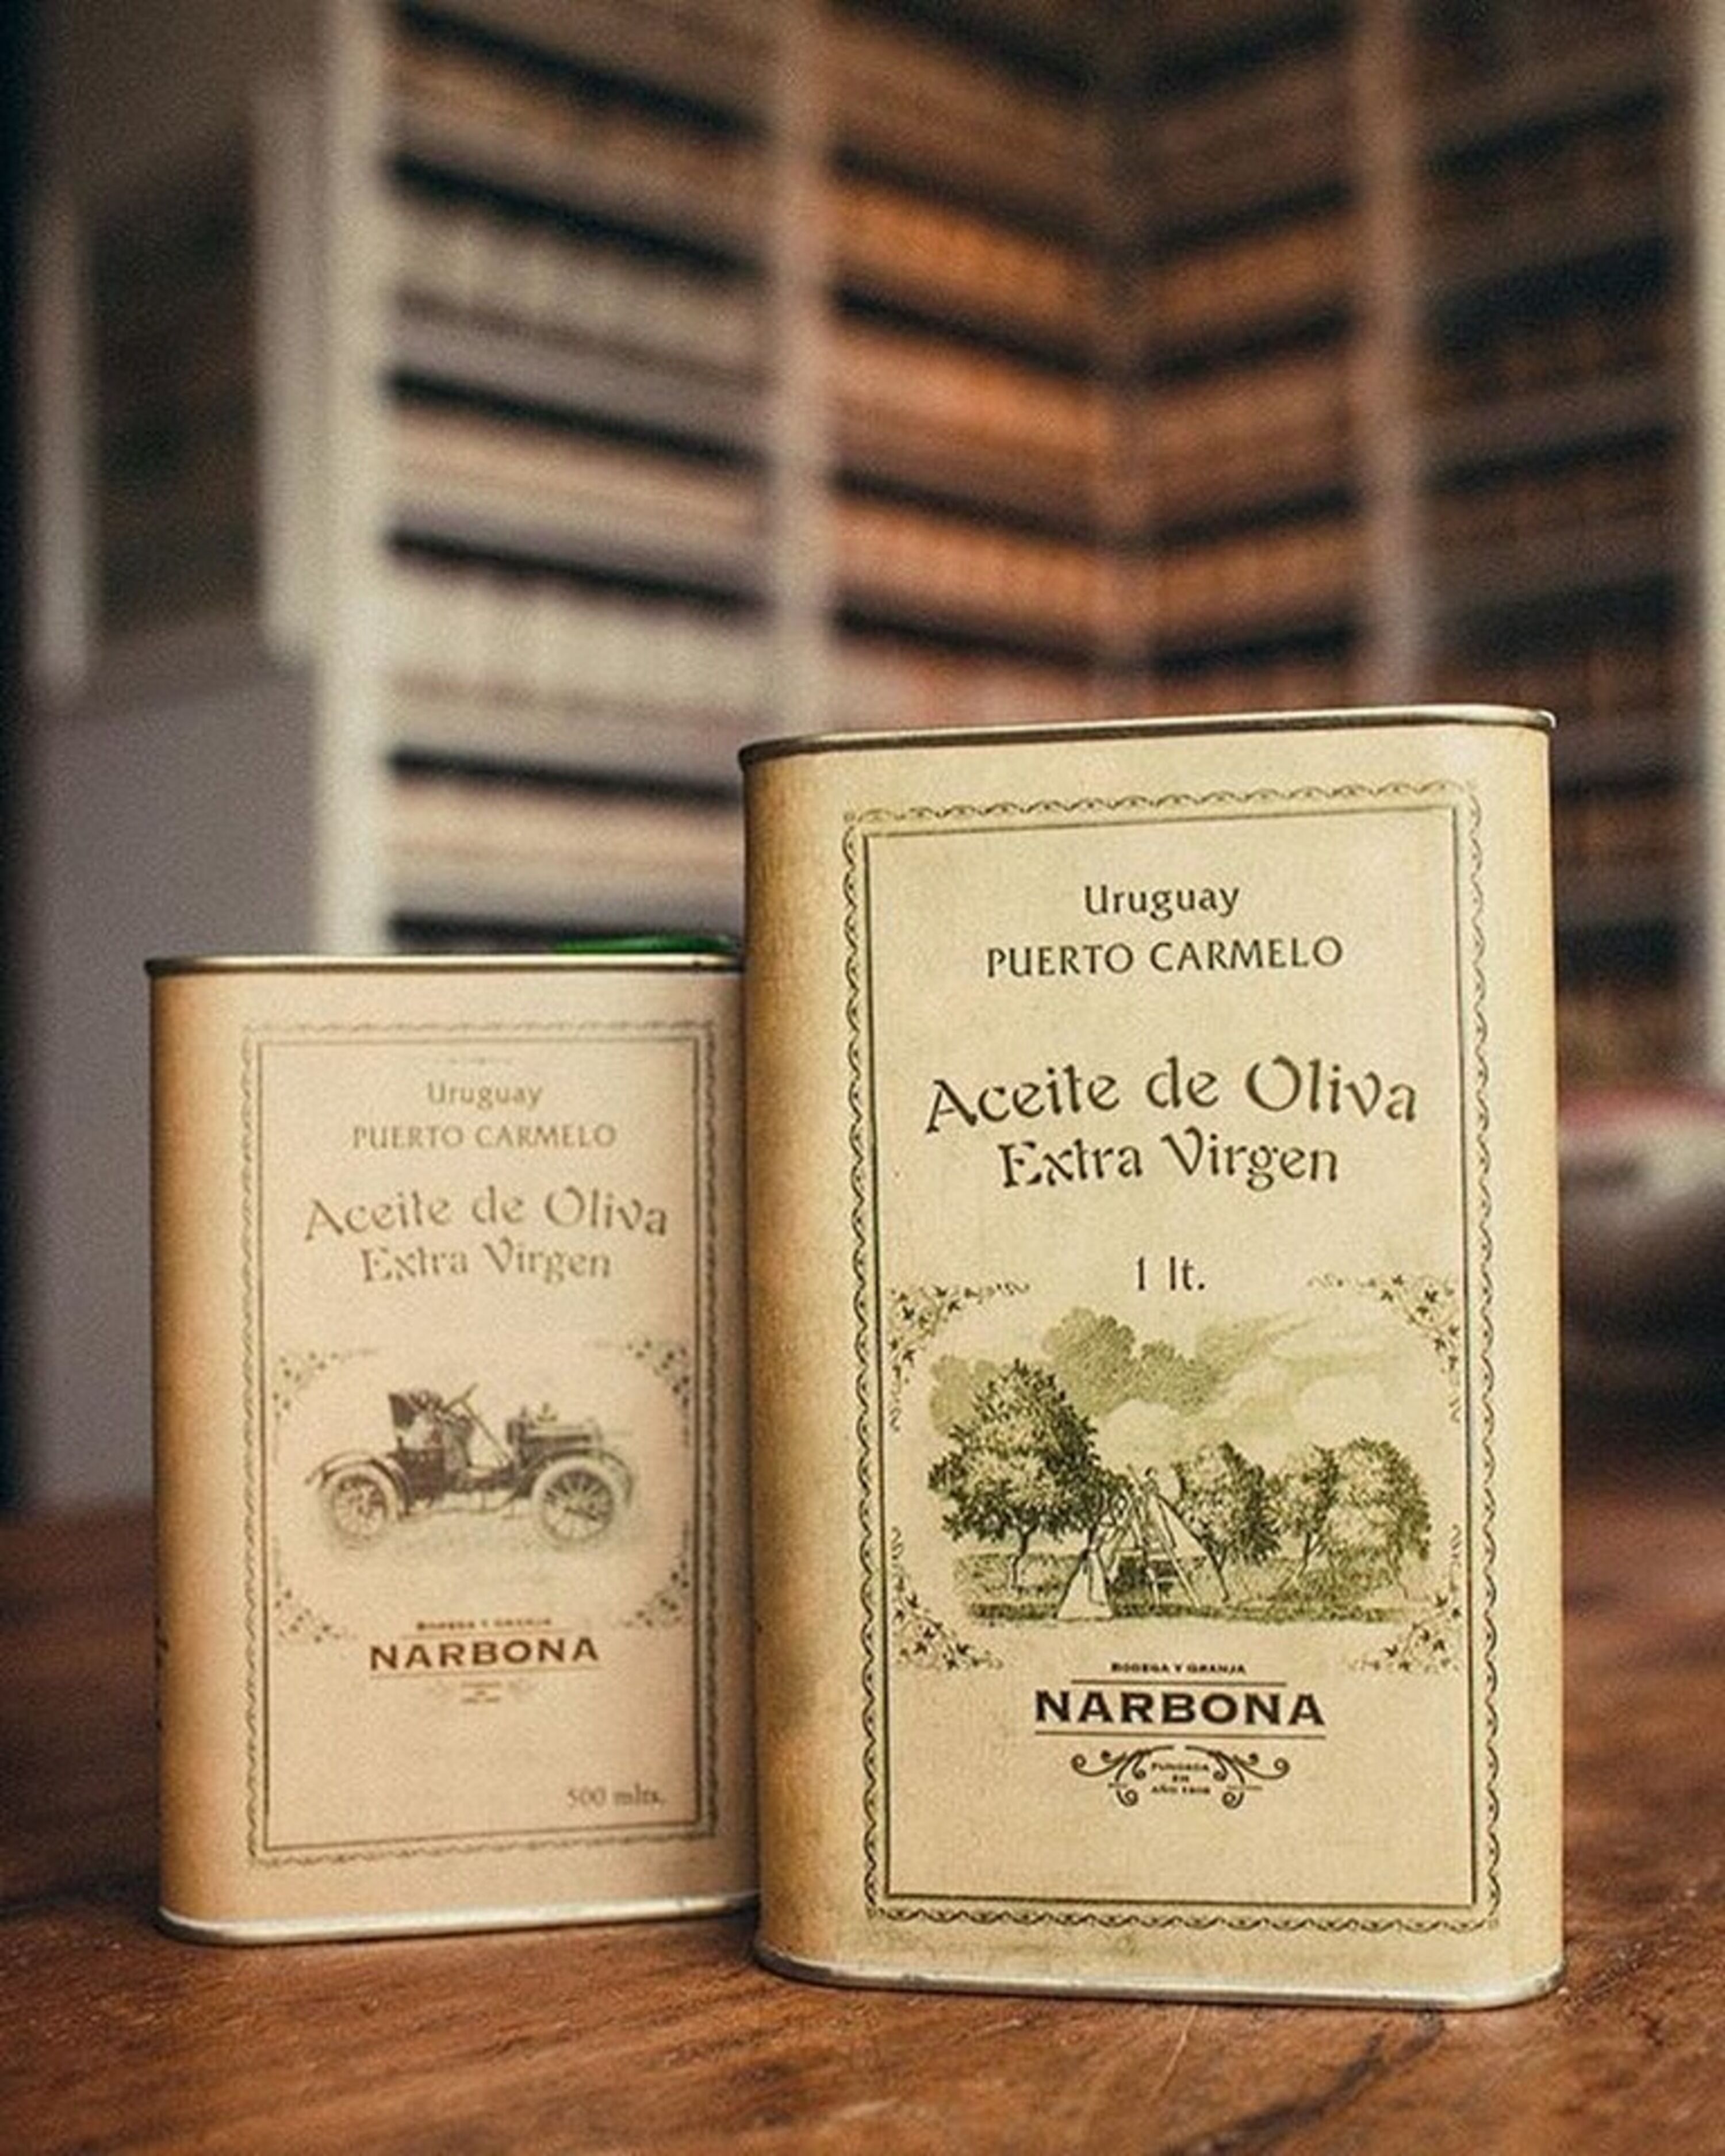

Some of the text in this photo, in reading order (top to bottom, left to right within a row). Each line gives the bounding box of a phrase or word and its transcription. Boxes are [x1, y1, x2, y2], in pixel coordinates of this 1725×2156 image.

[1084, 884, 1240, 922] Uruguay
[987, 935, 1344, 979] PUERTO CARMELO
[426, 1080, 544, 1112] Uruguay
[925, 1054, 1416, 1135] Aceite de Oliva
[352, 1122, 618, 1151] PUERTO CARMELO
[997, 1125, 1338, 1192] Extra Virgen
[304, 1184, 668, 1242] Aceite de Oliva
[359, 1234, 611, 1285] Extra Virgen
[1169, 1255, 1206, 1292] lt.
[370, 1636, 599, 1671] NARBONA
[1035, 1689, 1325, 1727] NARBONA
[566, 1785, 608, 1810] 500
